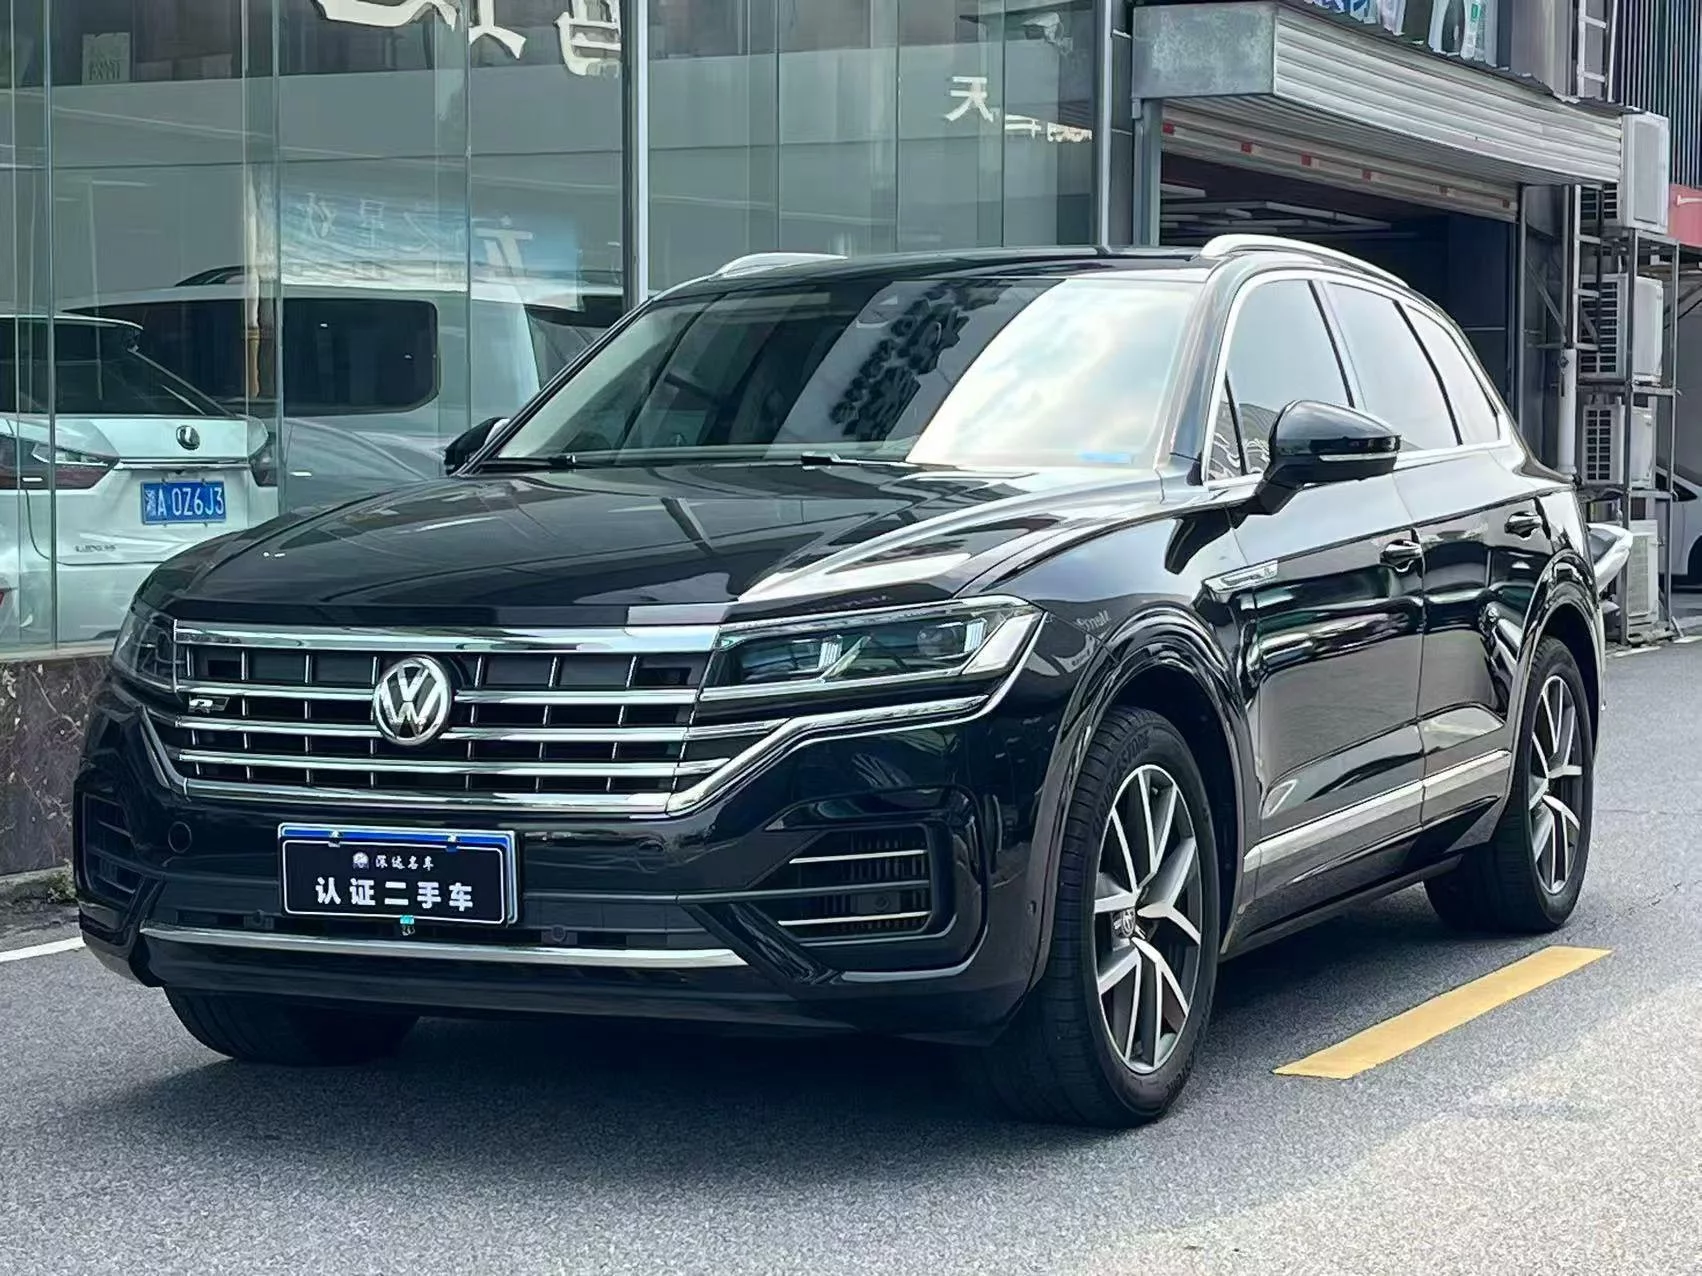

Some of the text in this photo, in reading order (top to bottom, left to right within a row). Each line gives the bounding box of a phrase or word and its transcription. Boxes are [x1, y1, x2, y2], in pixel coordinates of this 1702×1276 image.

[315, 876, 474, 912] 认证二手车
